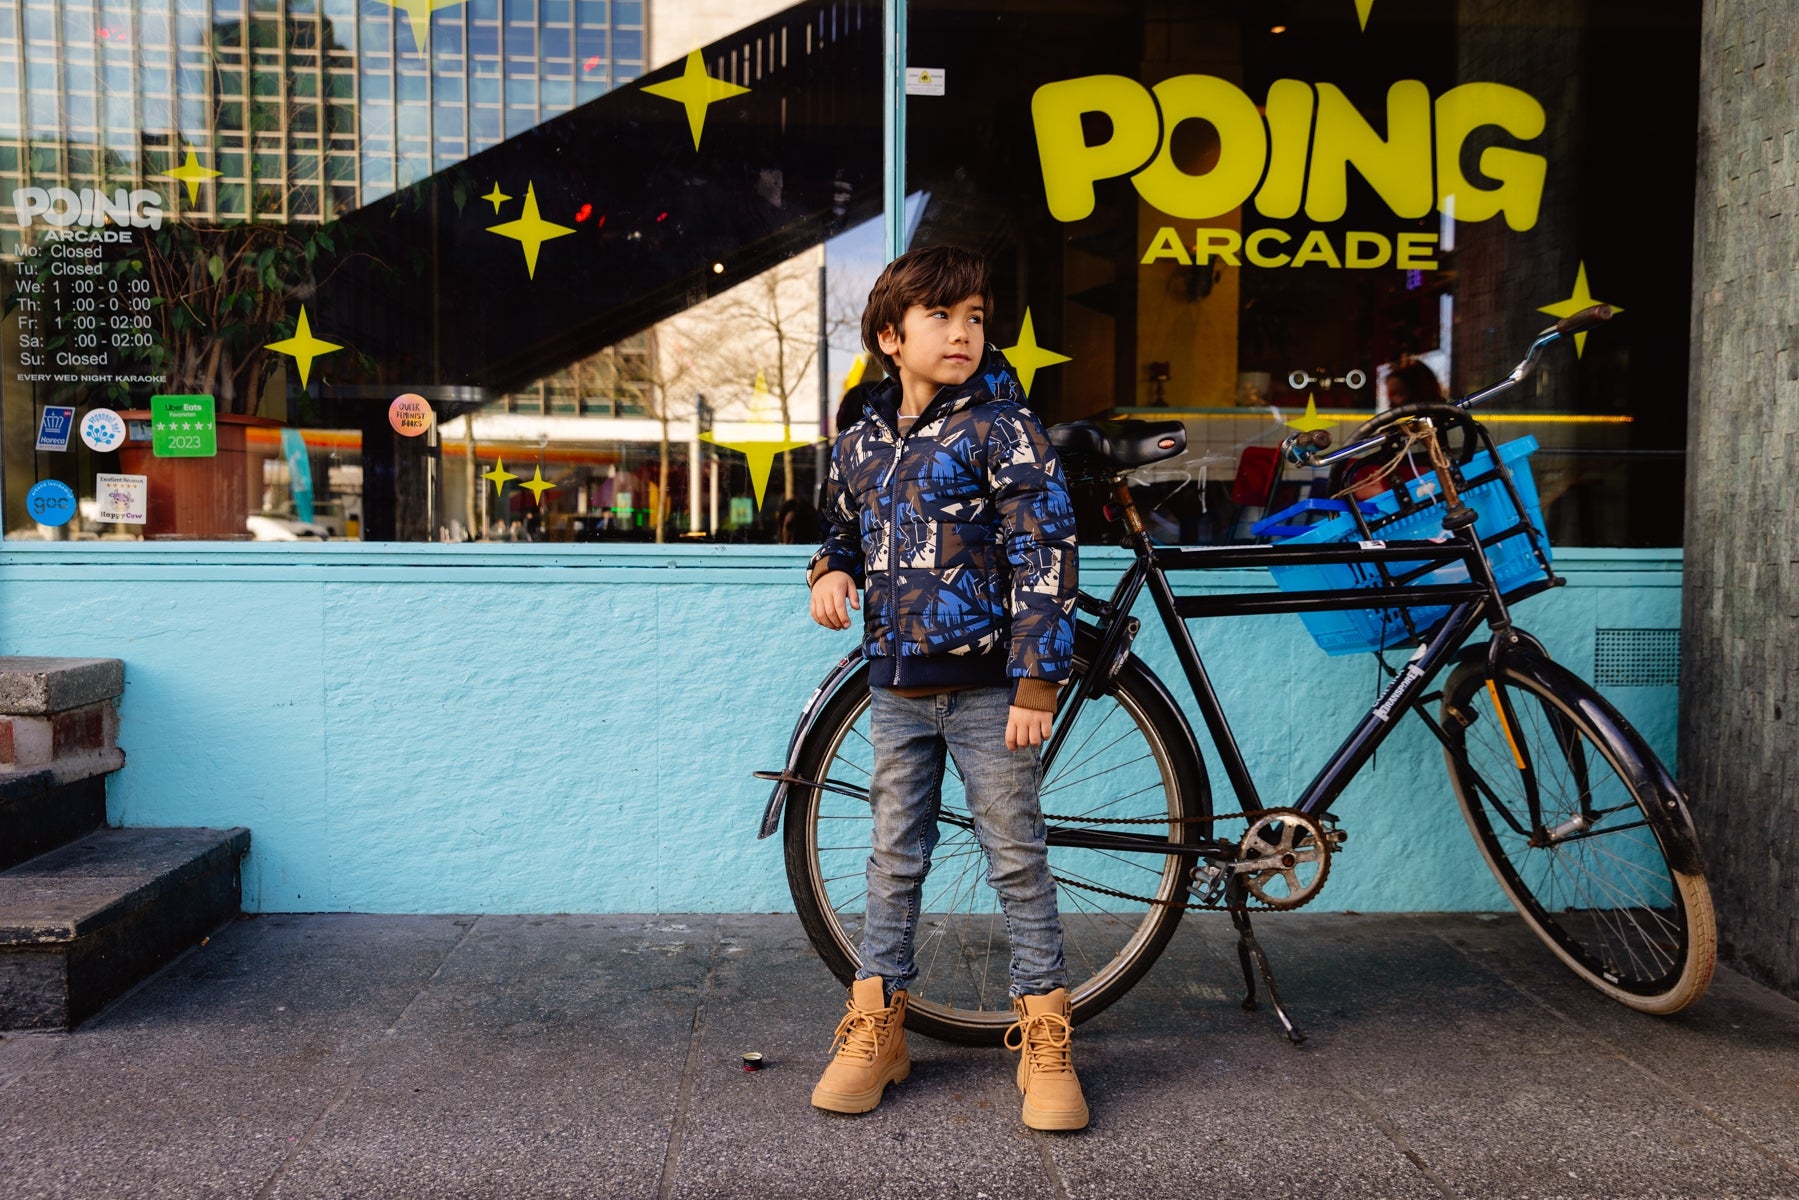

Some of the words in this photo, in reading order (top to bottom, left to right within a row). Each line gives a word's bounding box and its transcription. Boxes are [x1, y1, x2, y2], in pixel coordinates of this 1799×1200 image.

[1031, 73, 1548, 233] POING
[12, 186, 164, 231] POING
[44, 230, 133, 244] ARCADE
[14, 244, 42, 257] Mo:
[50, 244, 103, 258] Closed
[1140, 226, 1439, 270] ARCADE
[14, 262, 38, 275] Tu:
[51, 262, 103, 276] Closed
[15, 280, 45, 293] We:
[16, 298, 41, 311] Th:
[18, 317, 38, 330] Fr:
[110, 315, 152, 329] 02:00
[19, 334, 44, 347] Sa:
[111, 333, 153, 347] 02:00
[20, 352, 45, 366] Su:
[56, 352, 108, 366] Closed
[17, 374, 52, 382] EVERY
[54, 374, 78, 382] WED
[80, 374, 113, 382] NIGHT
[115, 375, 167, 383] KARAOKE
[399, 403, 420, 411] QUEER
[396, 411, 426, 419] FEMINIST
[40, 436, 66, 445] Horeca
[168, 435, 201, 449] 2023
[33, 497, 69, 515] goc
[1380, 670, 1418, 715] TRANSPORT
